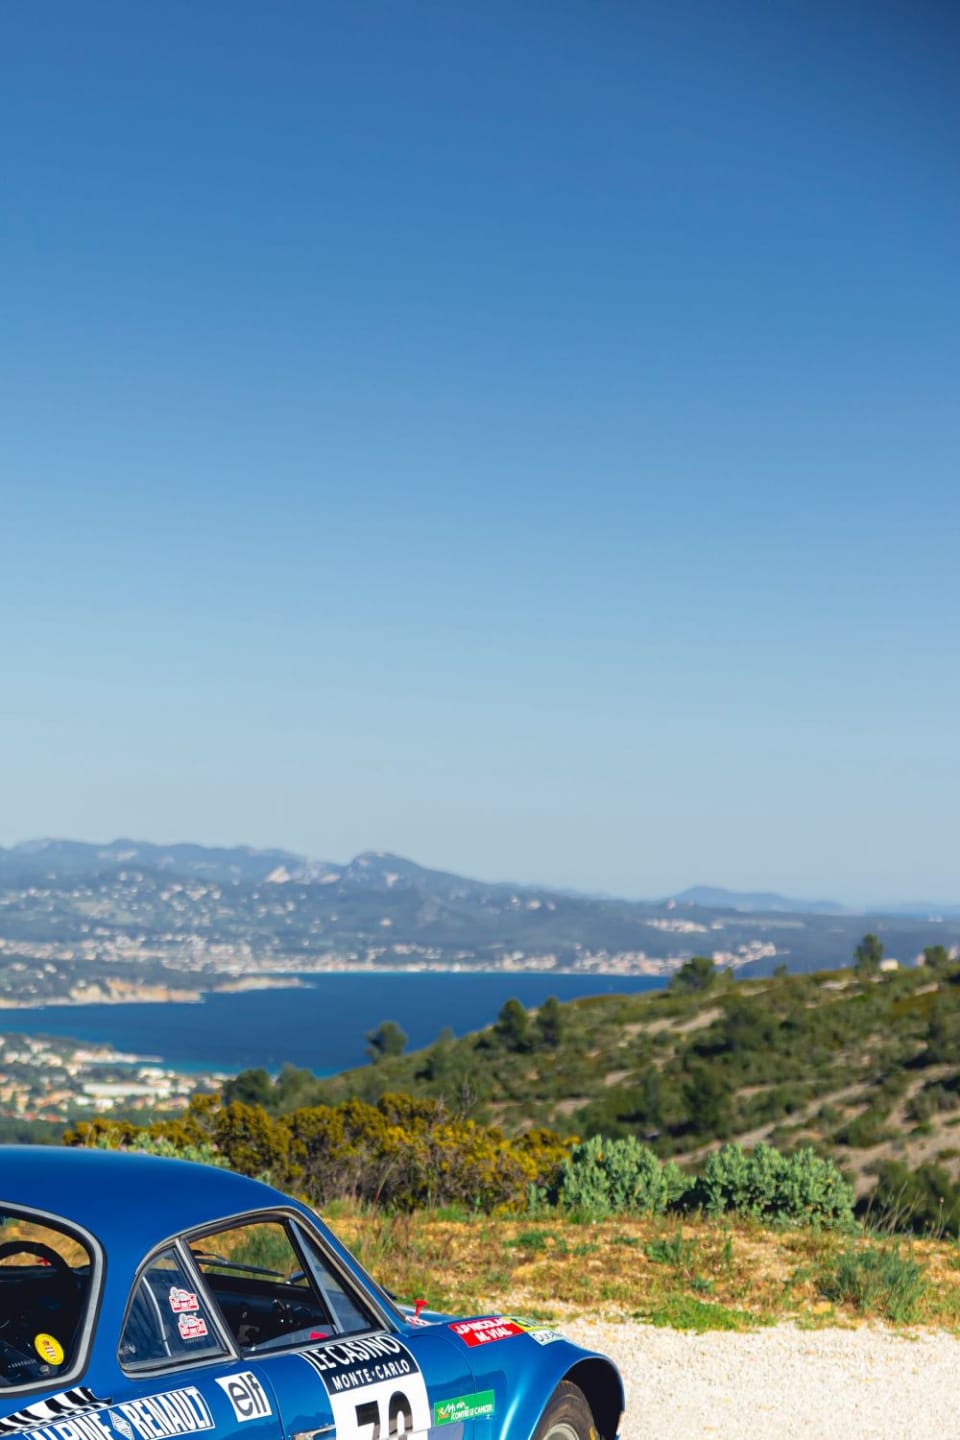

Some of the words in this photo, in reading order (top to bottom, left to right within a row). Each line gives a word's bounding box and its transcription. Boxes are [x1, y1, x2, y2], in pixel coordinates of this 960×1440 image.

[303, 1349, 336, 1371] LE
[324, 1335, 401, 1365] CASINO
[229, 1374, 267, 1417] elf
